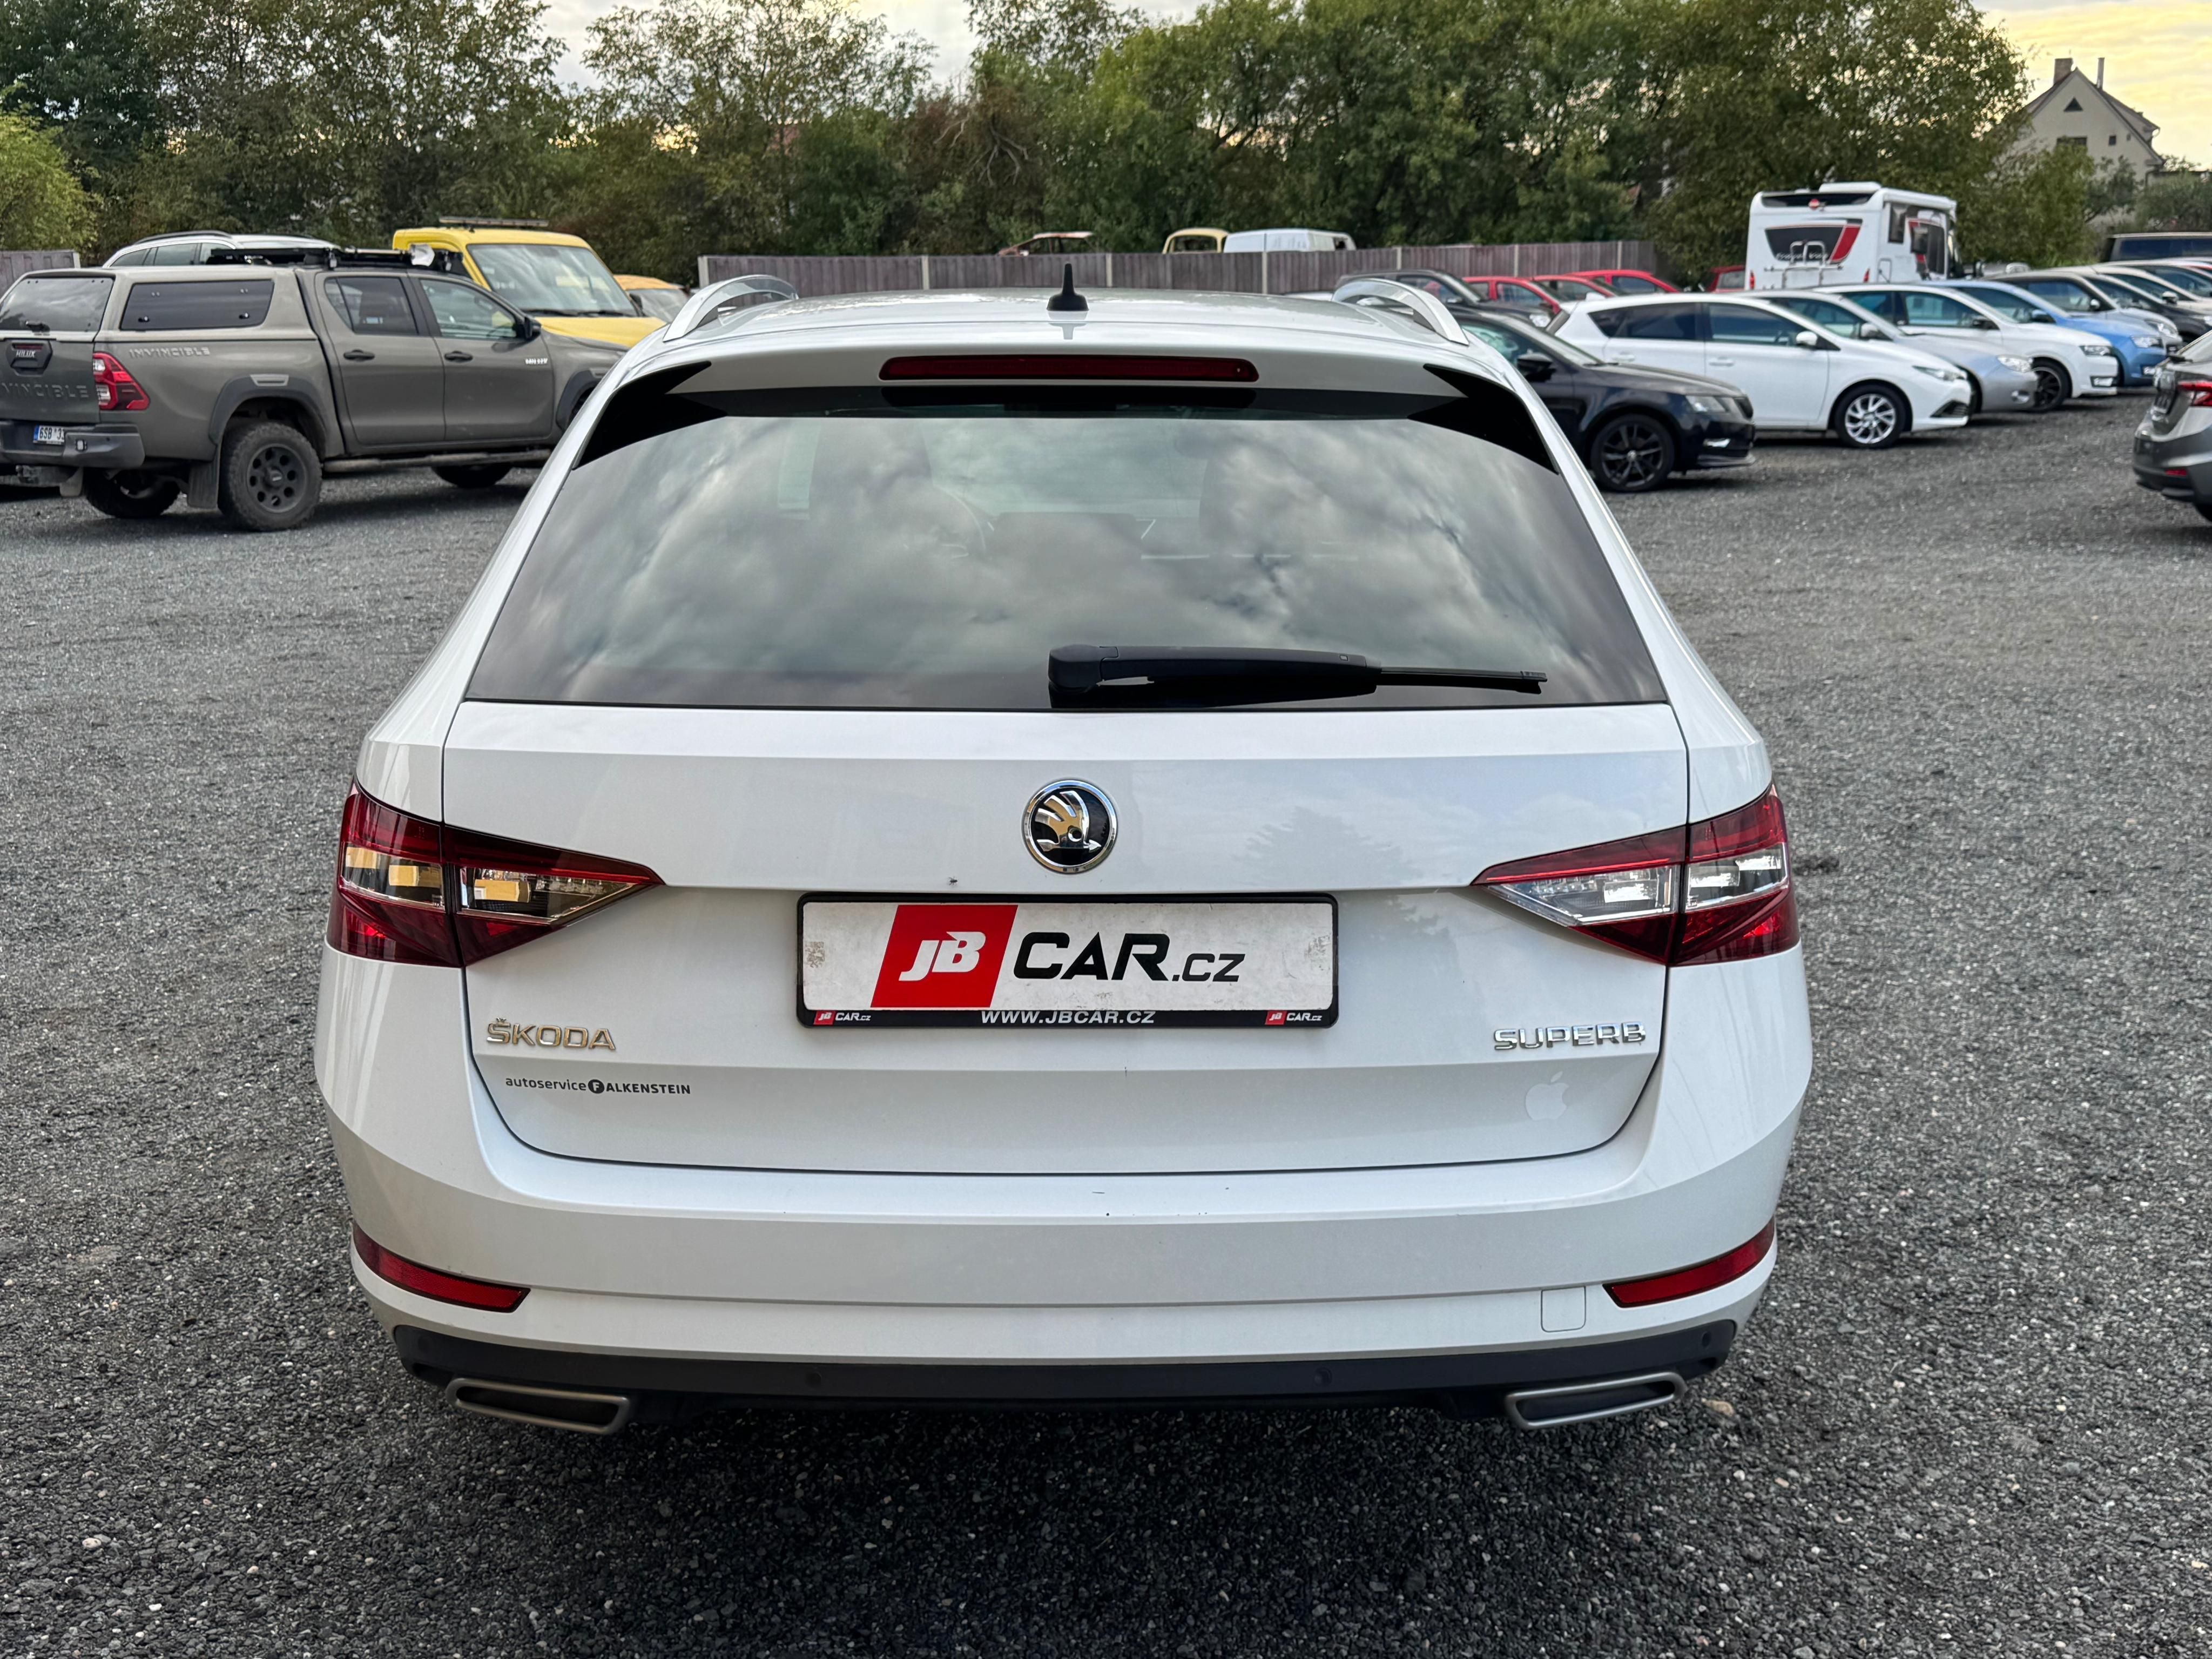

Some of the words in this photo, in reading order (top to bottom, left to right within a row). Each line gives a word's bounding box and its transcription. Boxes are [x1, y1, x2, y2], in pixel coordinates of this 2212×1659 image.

[129, 347, 211, 359] INVINCIBLE
[898, 931, 987, 982] JB
[981, 1010, 1156, 1024] WWW.JBCAR.CZ
[487, 1017, 616, 1051] ŠKODA
[1494, 1021, 1647, 1051] SUPERB
